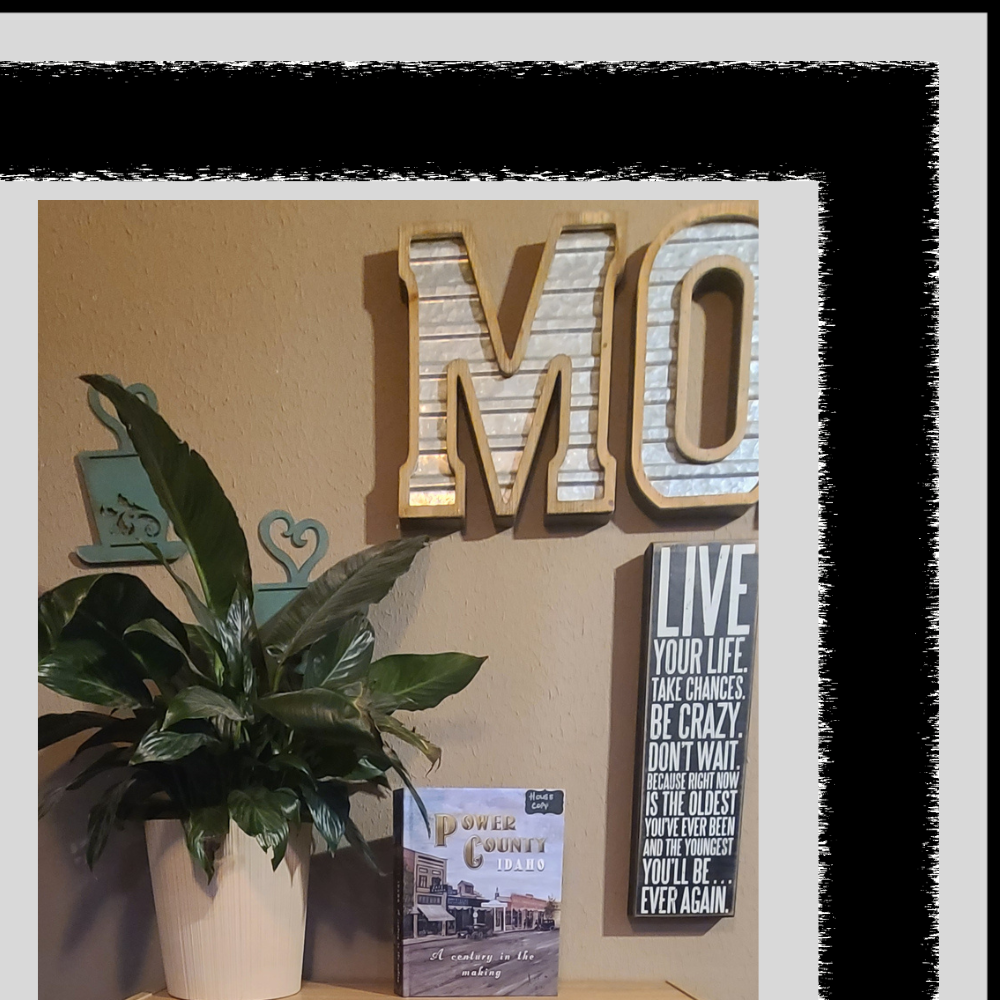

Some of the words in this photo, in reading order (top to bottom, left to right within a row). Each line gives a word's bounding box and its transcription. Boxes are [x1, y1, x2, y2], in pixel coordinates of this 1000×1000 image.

[657, 544, 756, 637] LIVE
[653, 639, 703, 675] YOUR
[708, 637, 747, 674] LIFE.
[652, 677, 681, 701] TAKE
[686, 676, 745, 700] CHANCES.
[650, 702, 674, 740] BE
[678, 702, 742, 739] CRAZY.
[648, 742, 694, 772] DON'T
[697, 740, 740, 771] WAIT.
[647, 773, 686, 790] BECAUSE
[689, 772, 714, 790] RIGHT
[716, 772, 739, 789] NOW
[646, 792, 658, 816] IS
[662, 791, 685, 816] THE
[689, 790, 737, 815] OLDEST
[434, 813, 516, 847] POWER
[645, 818, 679, 837] YOU'VE
[682, 817, 707, 837] EVER
[709, 817, 735, 836] BEEN
[464, 834, 547, 869] COUNTY
[643, 839, 663, 857] AND
[666, 839, 682, 856] THE
[685, 838, 734, 855] YOUNGEST
[497, 859, 545, 872] IDAHO
[643, 858, 689, 885] YOU'LL
[694, 859, 710, 884] BE
[641, 887, 677, 914] EVER
[680, 886, 728, 913] AGAIN.
[430, 949, 443, 961] A
[451, 953, 493, 963] century
[518, 950, 535, 961] the
[462, 966, 502, 979] making
